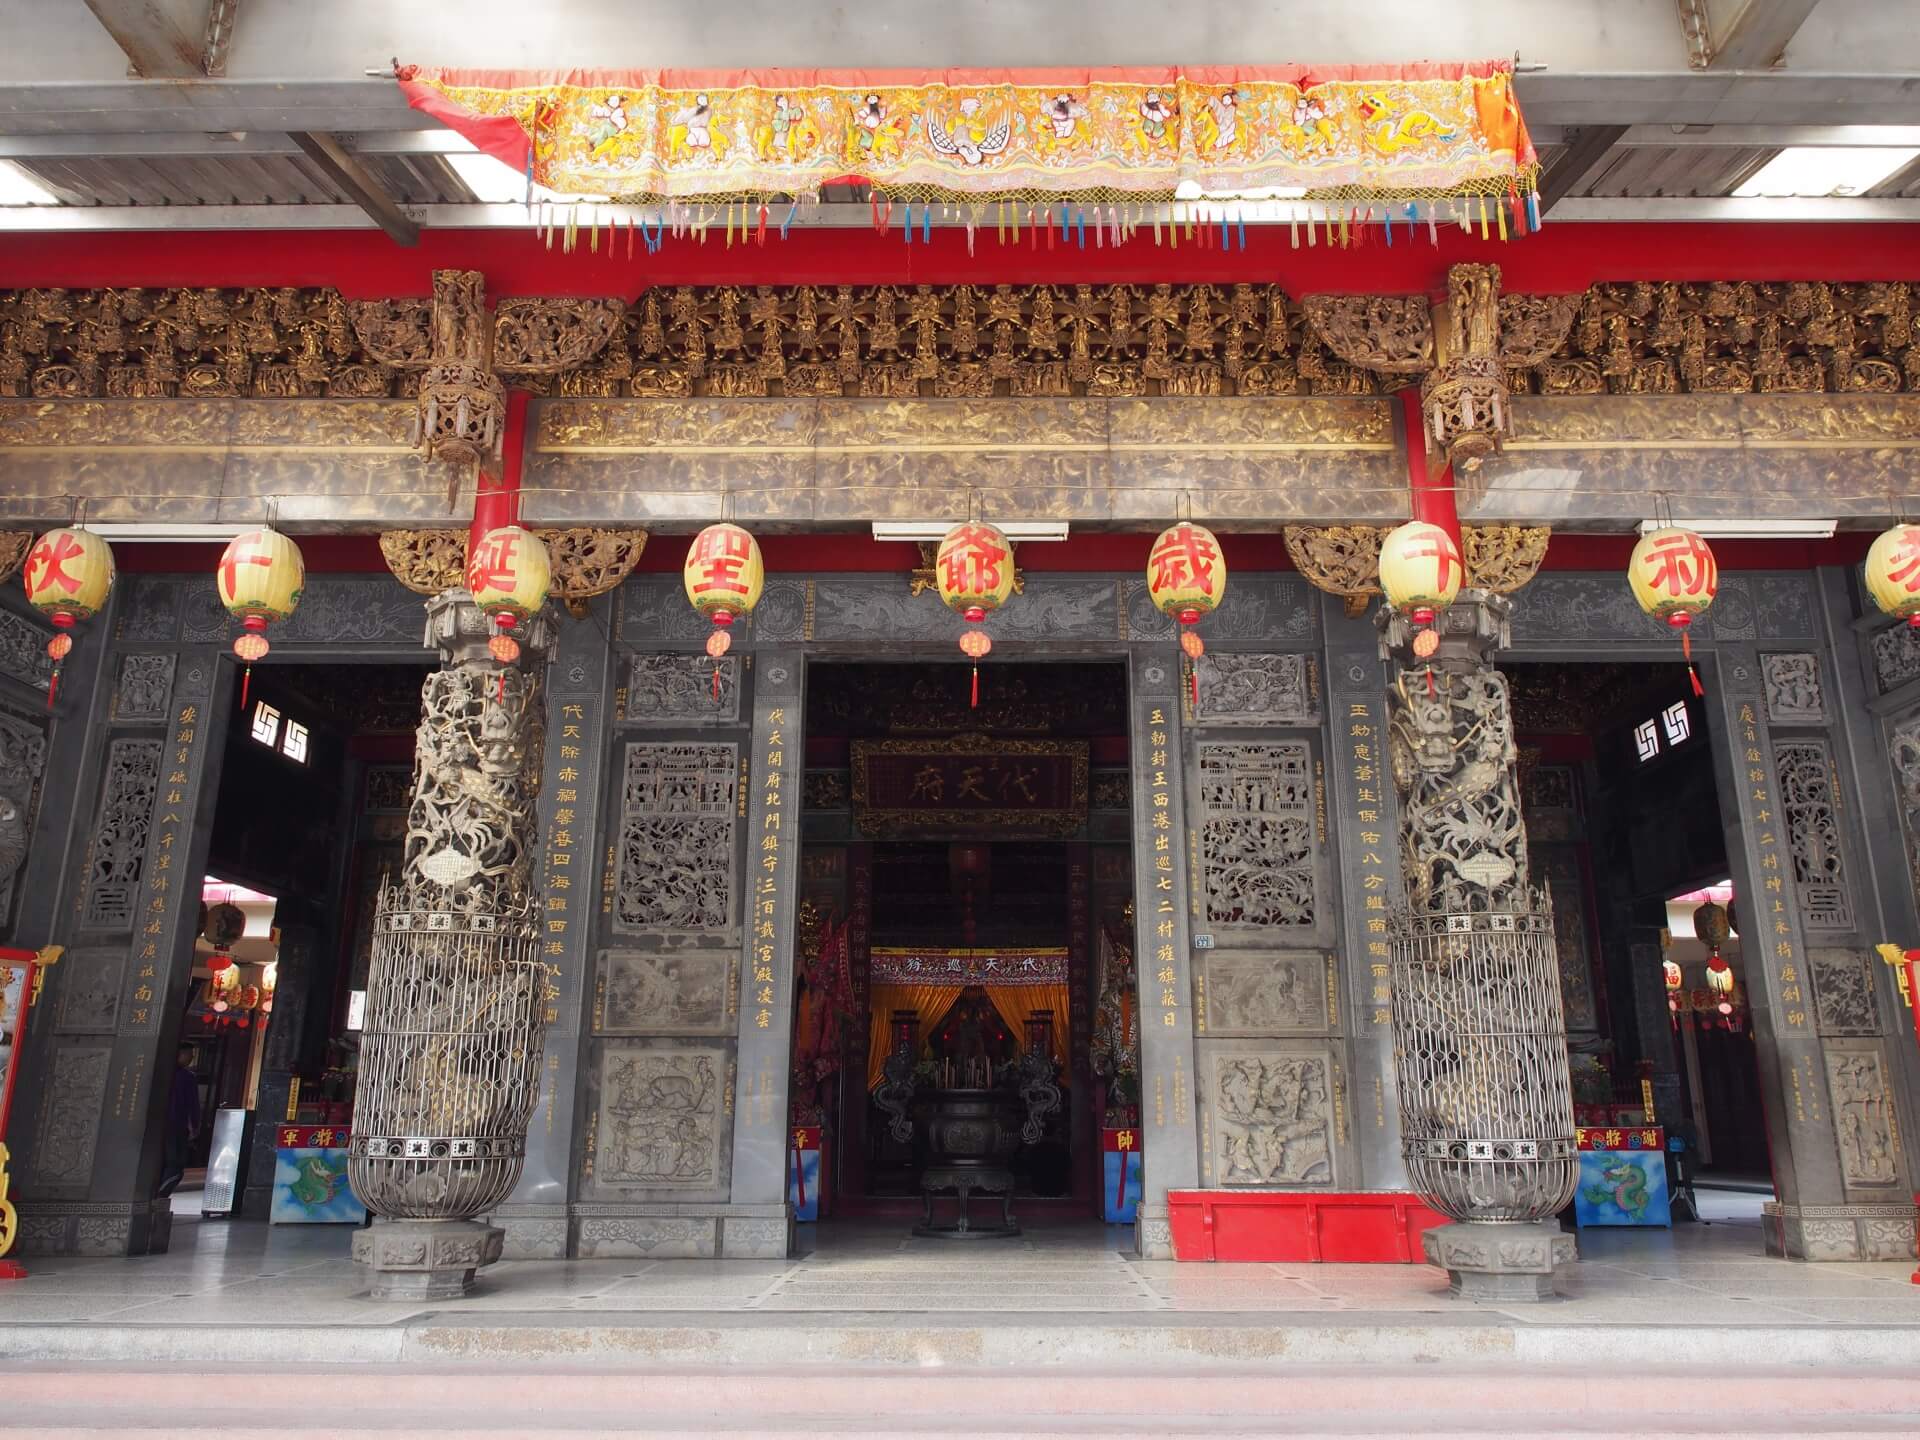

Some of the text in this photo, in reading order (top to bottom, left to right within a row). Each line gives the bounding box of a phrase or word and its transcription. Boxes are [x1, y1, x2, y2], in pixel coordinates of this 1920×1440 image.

[24, 533, 85, 599] 秋
[688, 529, 753, 595] 聖
[938, 526, 1007, 595] 爺
[1644, 534, 1716, 597] 祝
